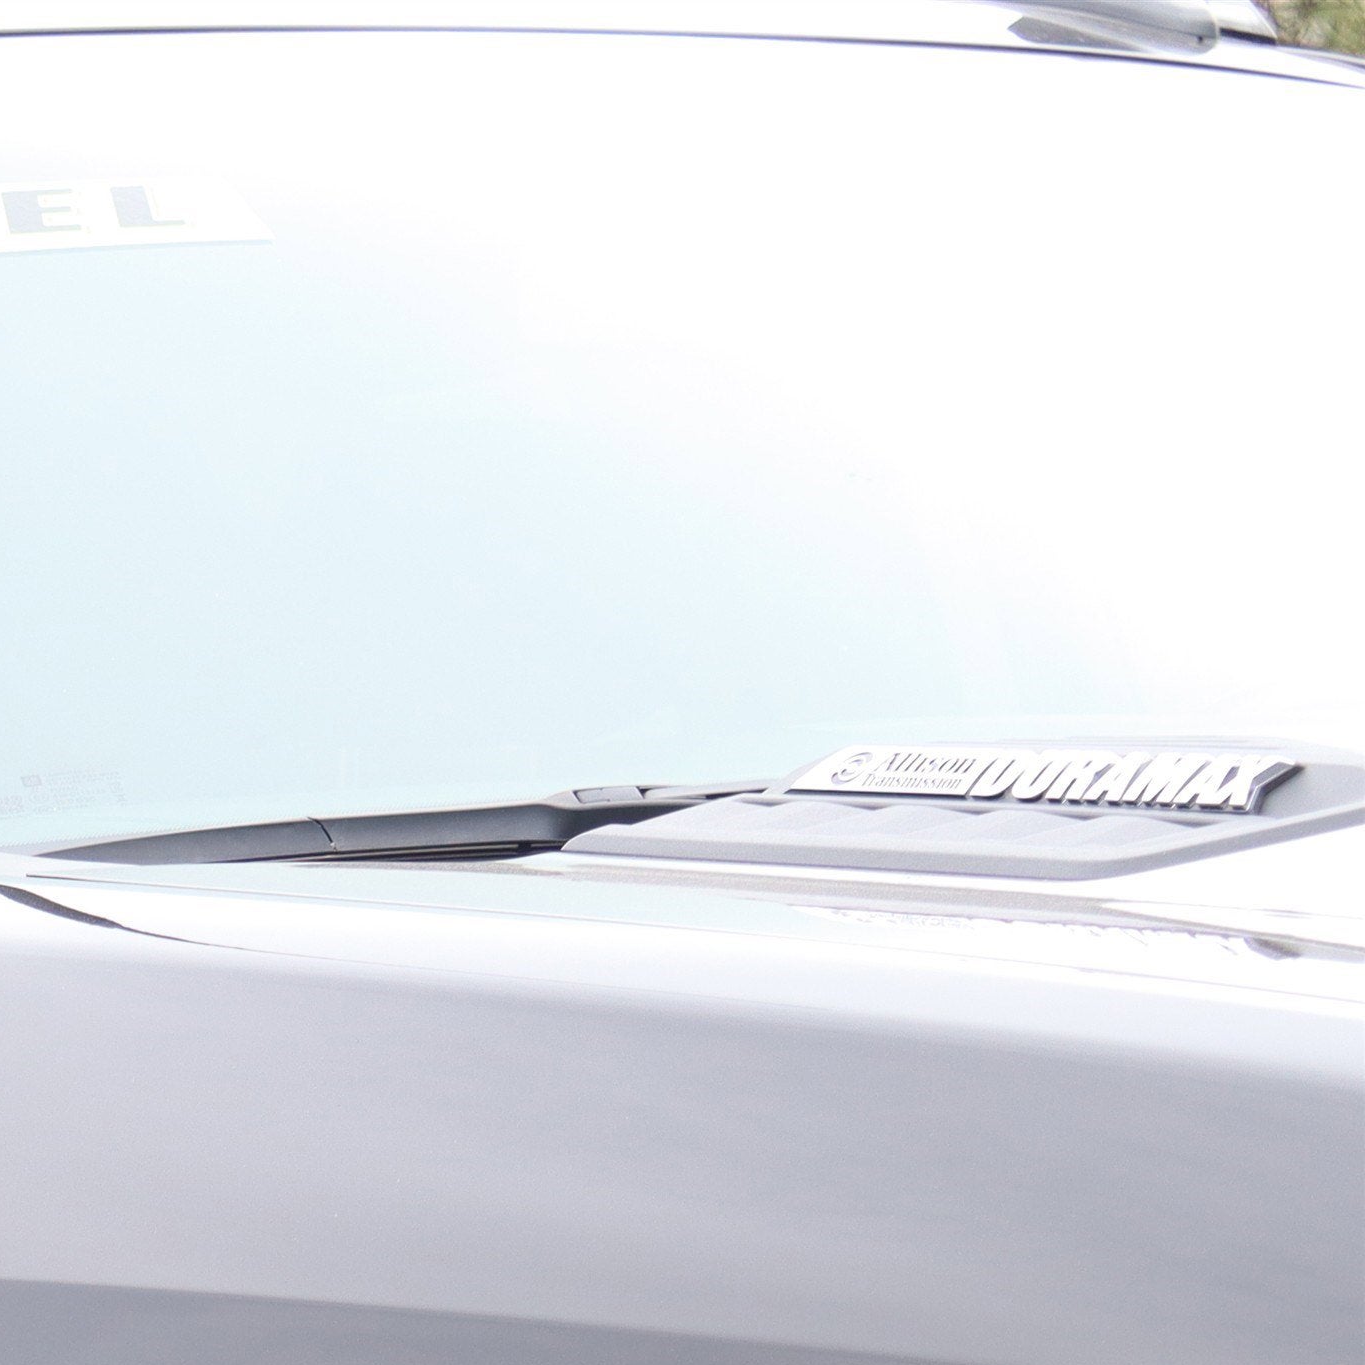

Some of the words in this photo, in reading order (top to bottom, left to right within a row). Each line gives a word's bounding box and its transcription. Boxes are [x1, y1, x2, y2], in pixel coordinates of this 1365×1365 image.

[873, 752, 977, 774] Allison
[861, 773, 963, 789] Transmission
[967, 750, 1299, 811] DURAMAX
